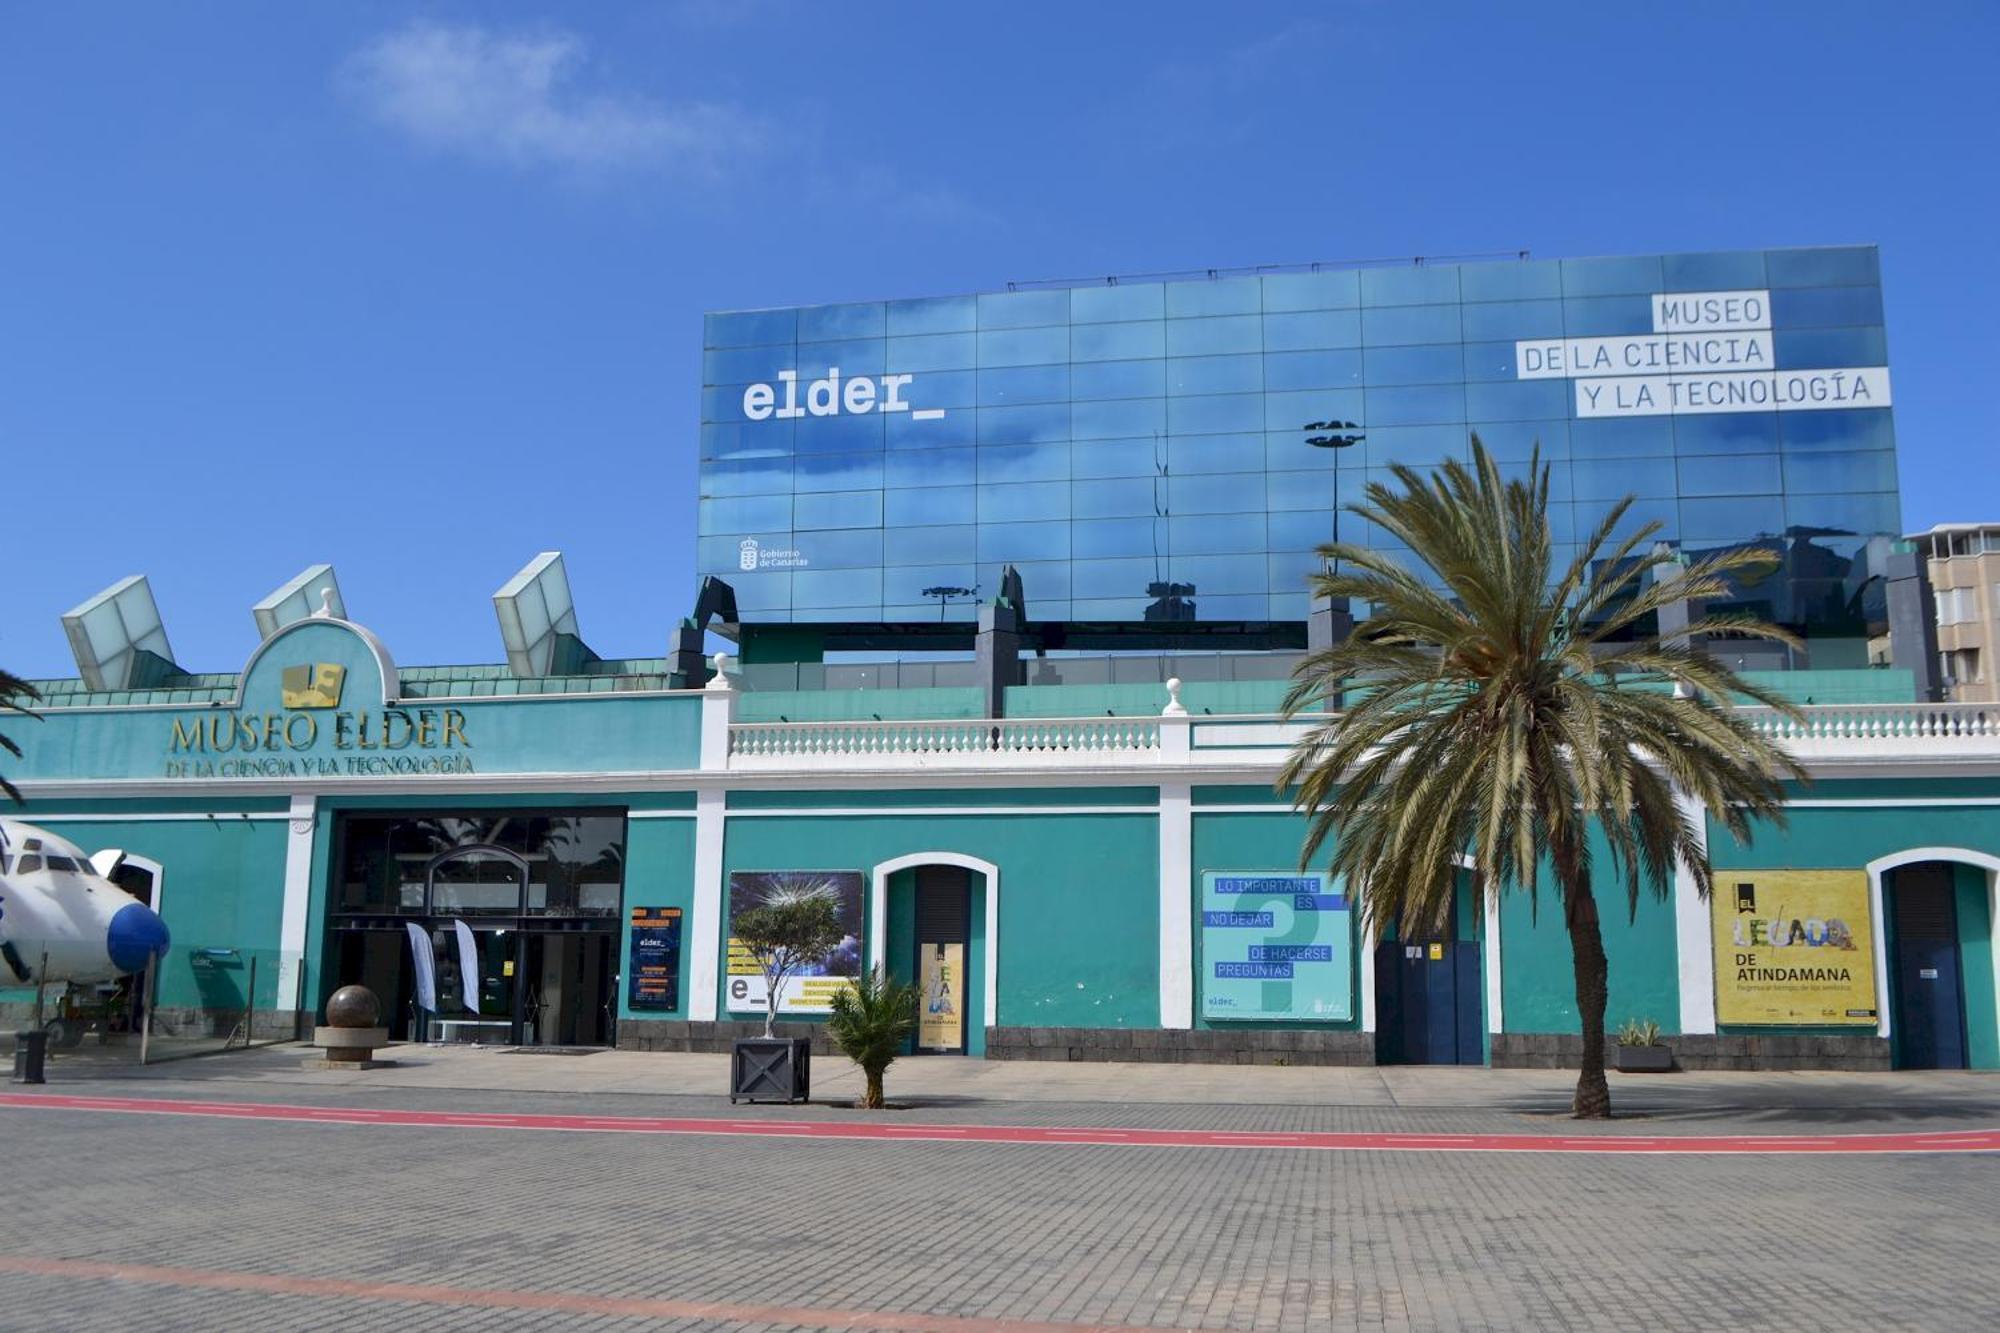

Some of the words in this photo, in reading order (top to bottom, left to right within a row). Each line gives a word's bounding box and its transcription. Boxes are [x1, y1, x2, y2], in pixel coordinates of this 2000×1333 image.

[1661, 298, 1762, 326] MUSEO
[1525, 346, 1563, 373] DE
[1573, 343, 1612, 370] LA
[1624, 339, 1764, 368] CIENCIA
[1583, 385, 1603, 409] Y
[1616, 382, 1654, 409] LA
[1667, 371, 1872, 406] TECNOLOGÍA
[759, 549, 801, 559] Gobierno
[759, 559, 770, 567] de
[171, 710, 319, 753] MUSEO
[334, 708, 473, 750] ELDER
[166, 760, 190, 778] DE
[300, 757, 314, 777] Y
[1217, 880, 1233, 892] LO
[1236, 880, 1318, 892] IMPORTANTE
[1297, 896, 1314, 909] ES
[1210, 914, 1227, 926] NO
[1230, 914, 1272, 926] DEJAR
[1251, 947, 1268, 960] DE
[1271, 947, 1329, 960] HACERSE
[1736, 953, 1757, 966] DE
[1217, 963, 1290, 977] PREGUNTAS
[1737, 967, 1852, 982] ATINDAMANA
